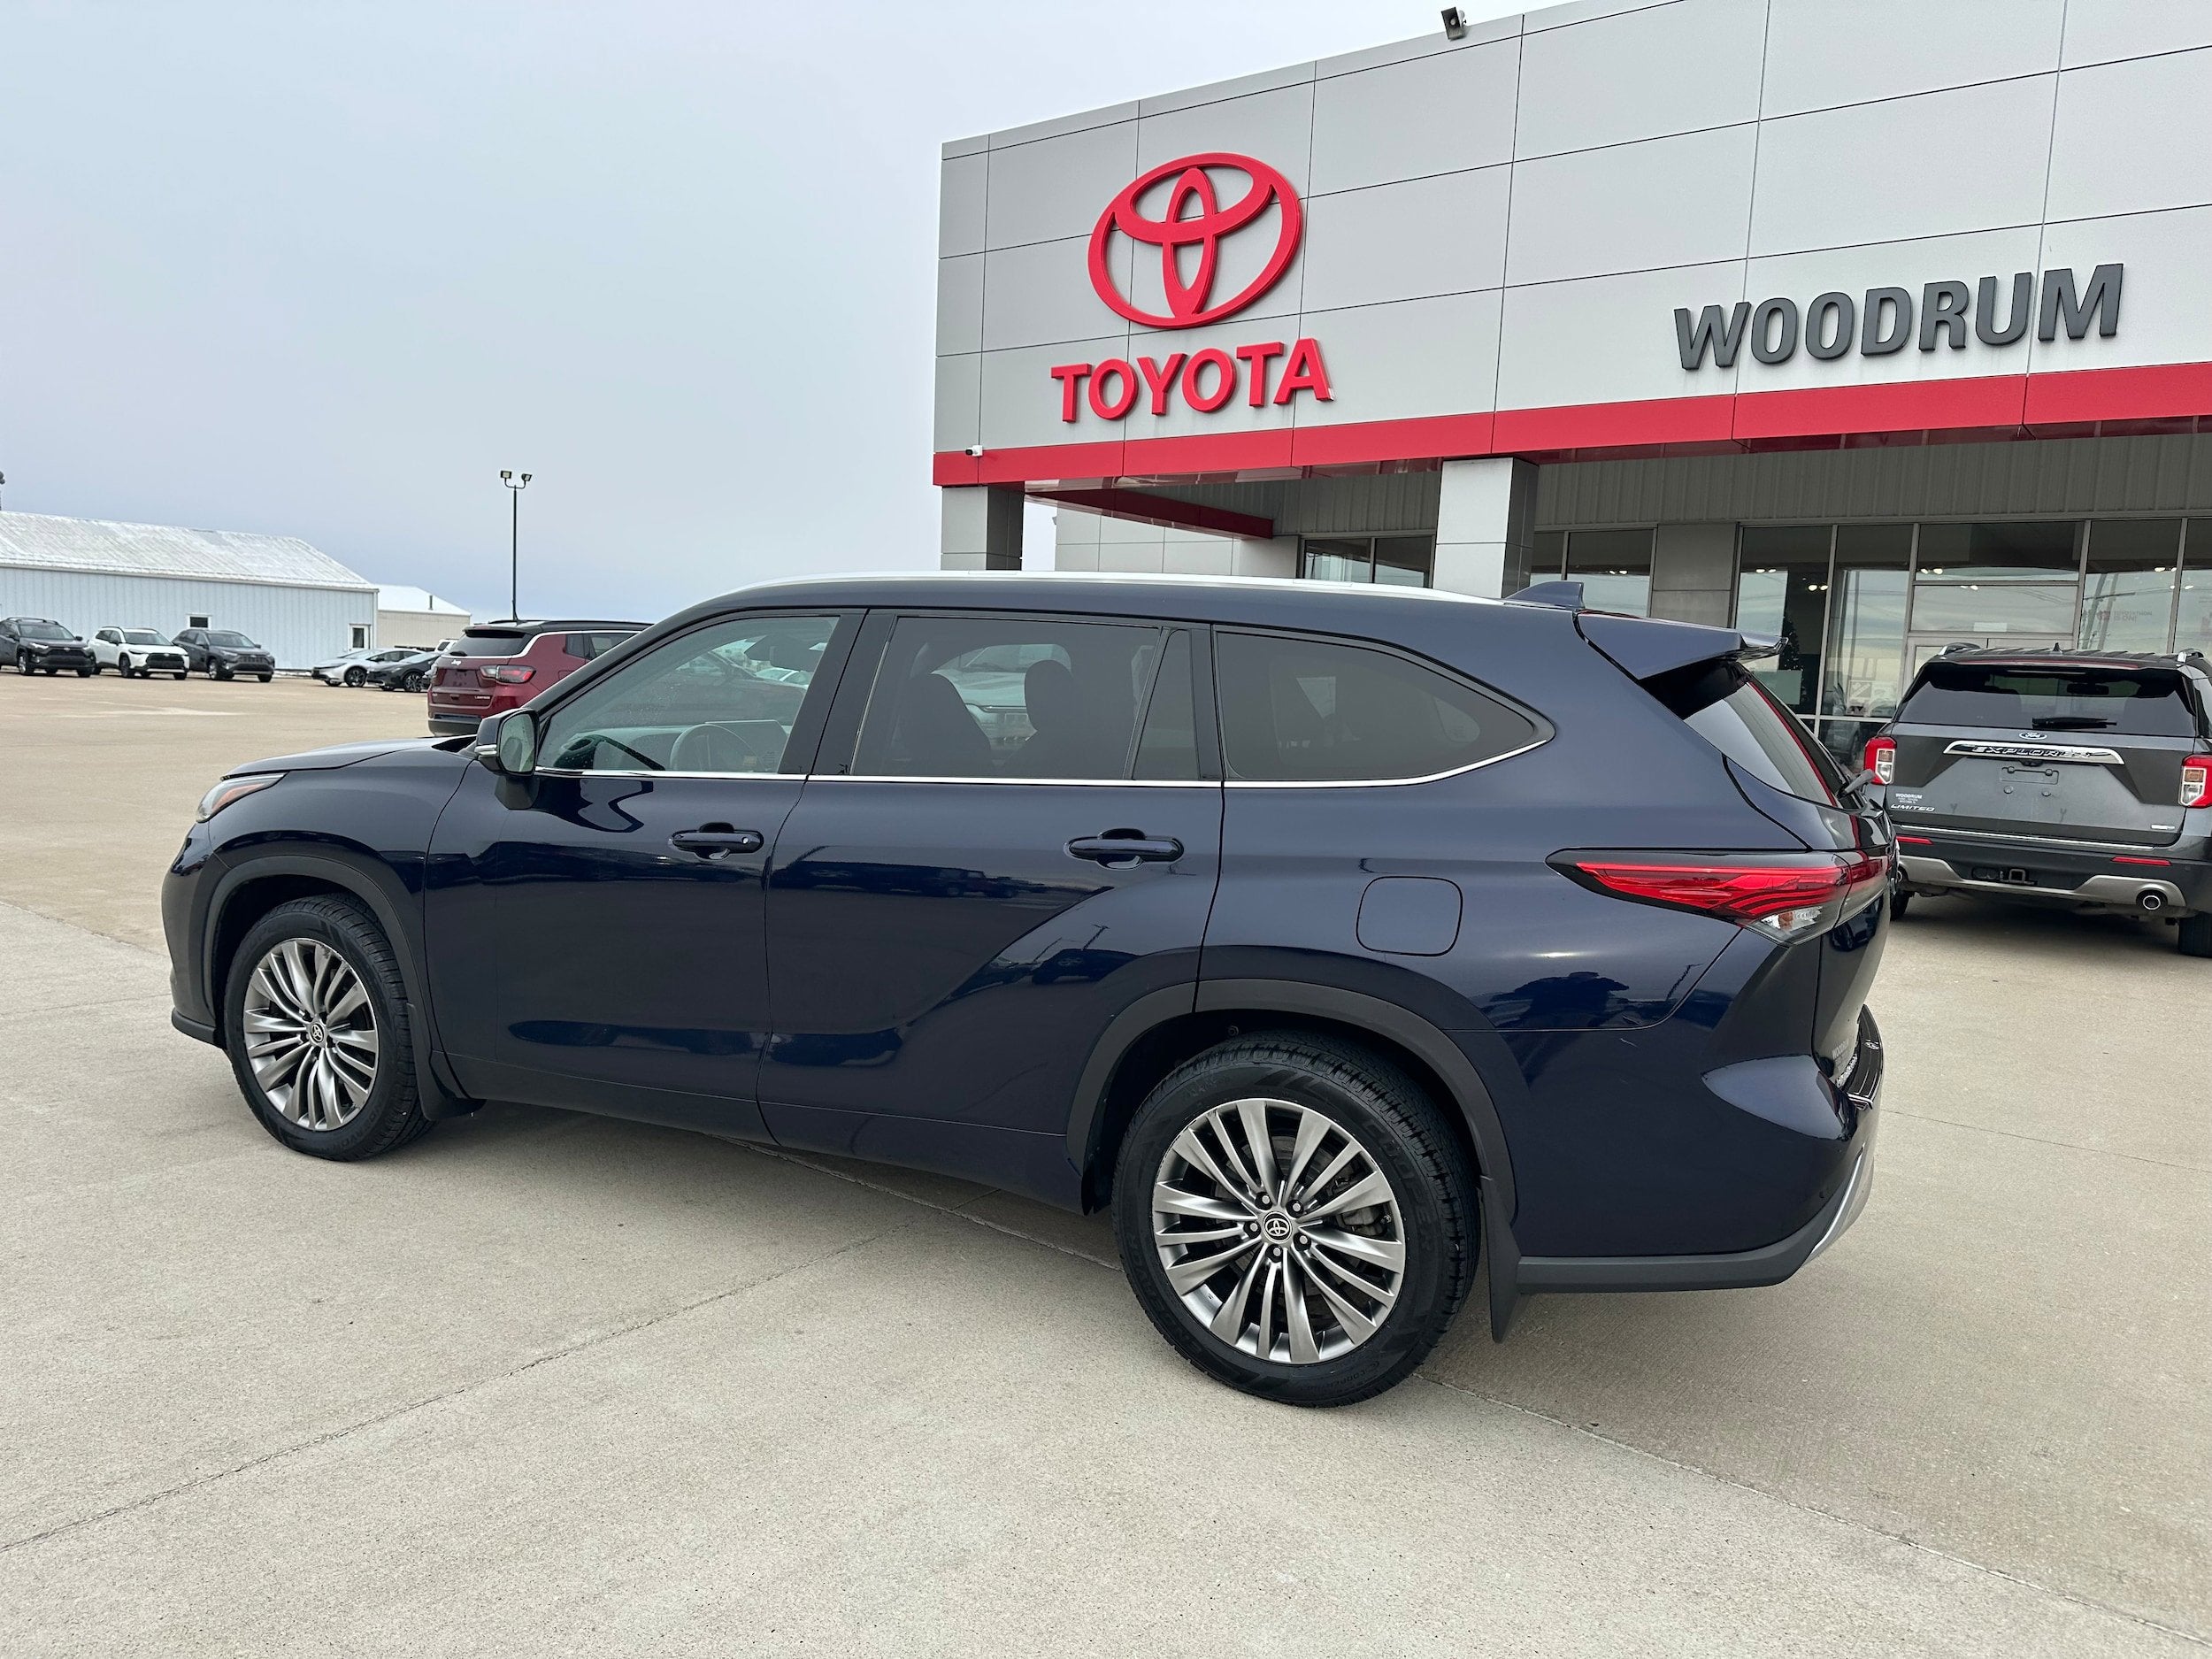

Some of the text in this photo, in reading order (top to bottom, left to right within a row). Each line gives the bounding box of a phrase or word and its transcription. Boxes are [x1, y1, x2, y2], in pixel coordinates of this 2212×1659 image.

[1673, 263, 2124, 371] WOODRUM
[1050, 338, 1334, 423] TOYOTA
[1971, 745, 2091, 758] EXPLORER
